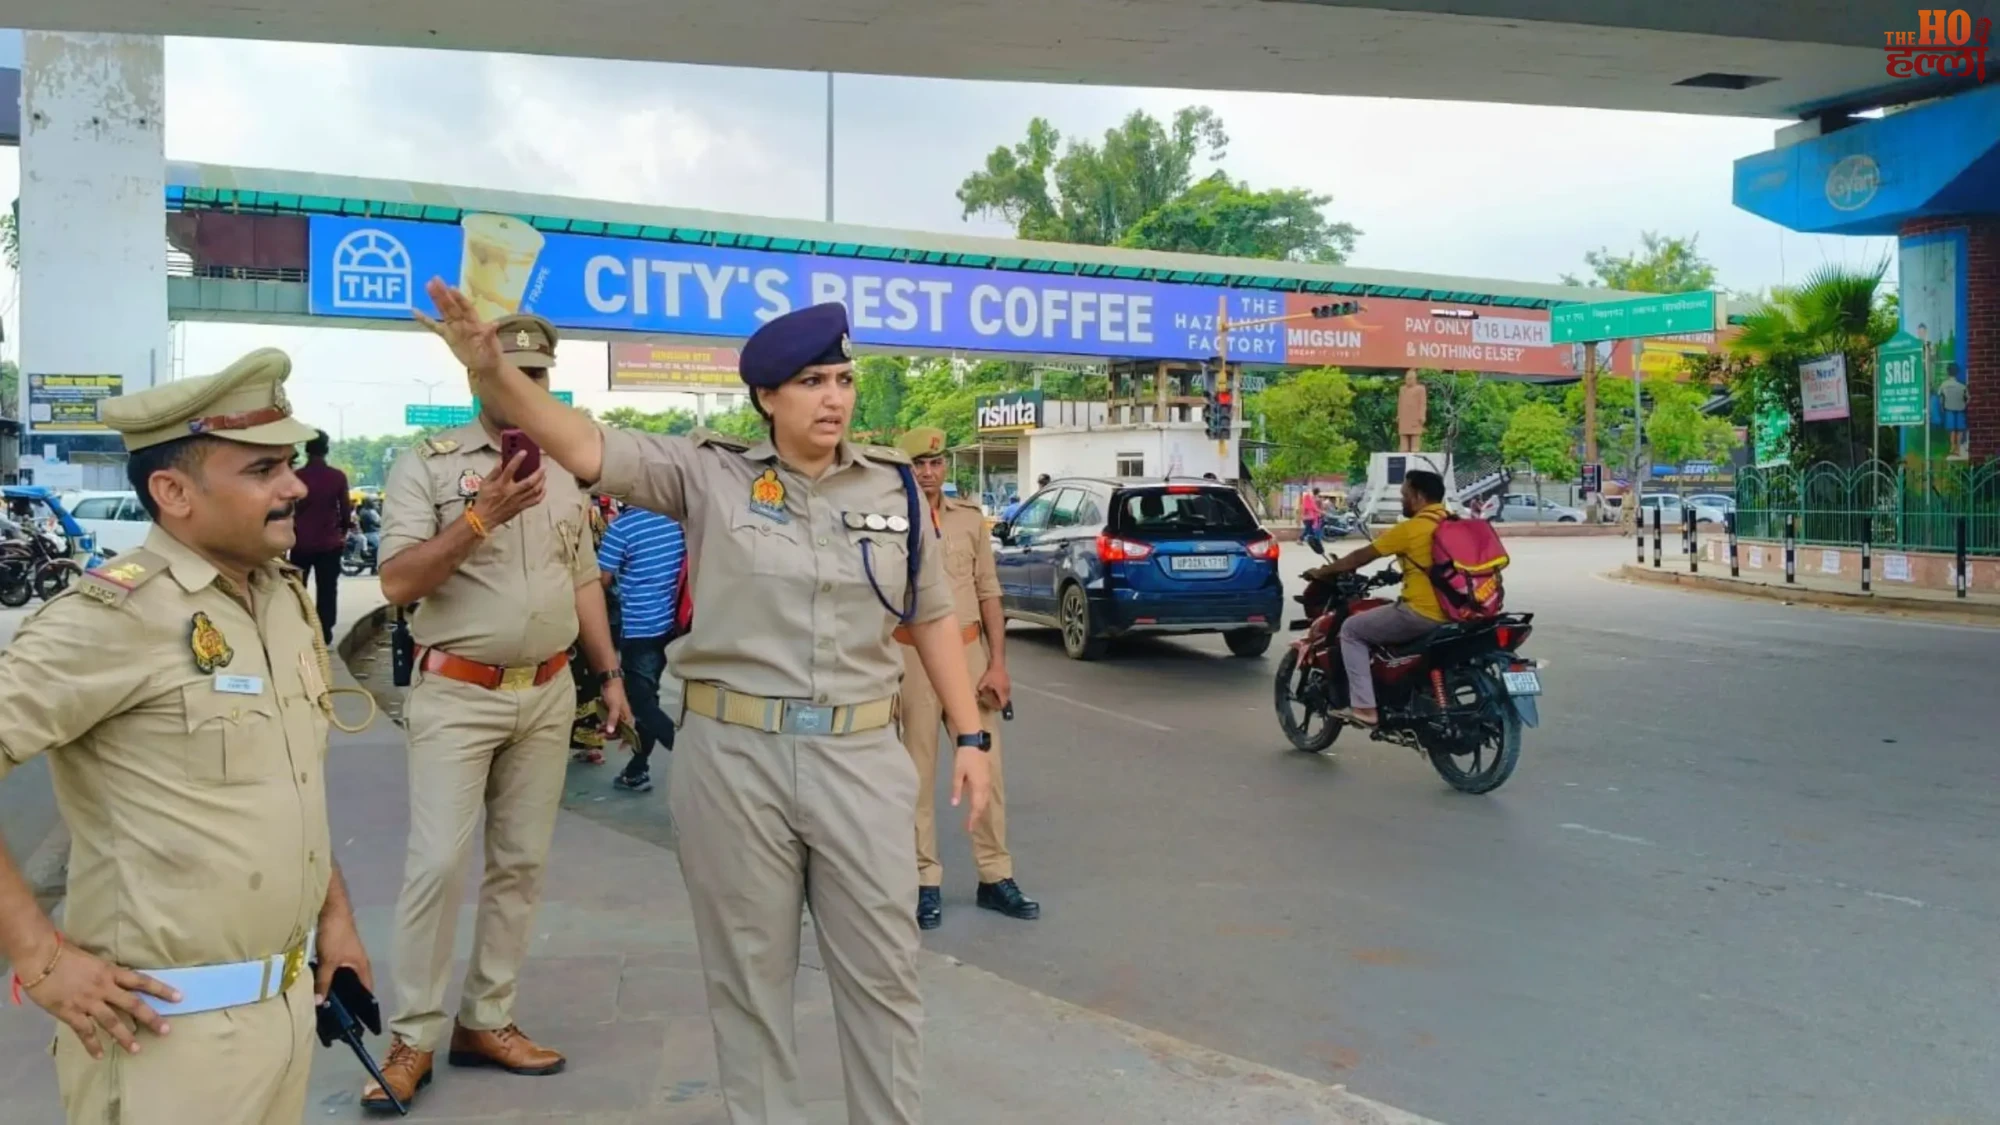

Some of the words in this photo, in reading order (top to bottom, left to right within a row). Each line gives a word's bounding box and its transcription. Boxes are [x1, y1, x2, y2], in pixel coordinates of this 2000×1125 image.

[342, 274, 403, 301] THF
[584, 254, 792, 323] CITY'S
[810, 271, 953, 333] BEST
[969, 284, 1155, 344] COFFEE
[1241, 297, 1278, 315] THE
[1405, 317, 1431, 334] PAY
[1434, 318, 1471, 336] ONLY
[1187, 333, 1277, 354] FACTORY
[1287, 328, 1362, 349] MIGSUN
[1406, 341, 1416, 357] &
[1419, 343, 1483, 360] NOTHING
[978, 396, 1036, 427] rishita
